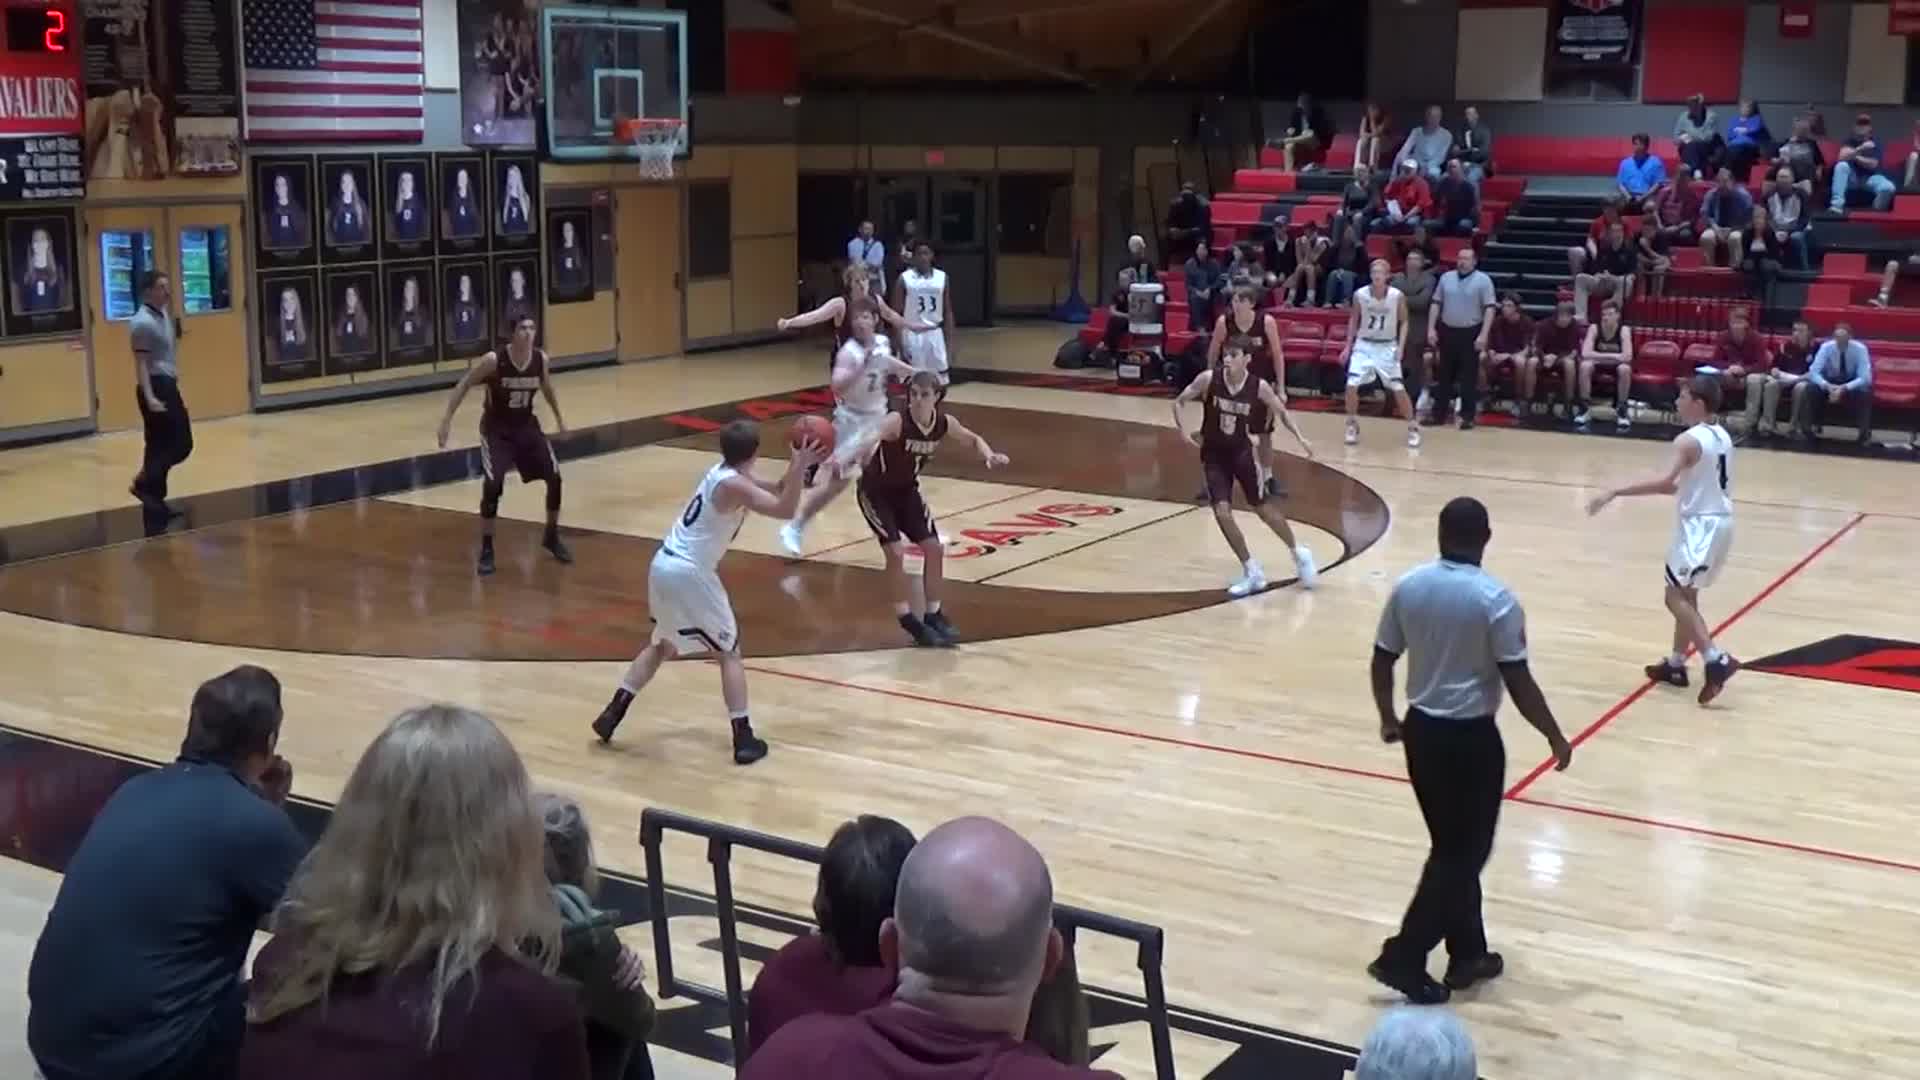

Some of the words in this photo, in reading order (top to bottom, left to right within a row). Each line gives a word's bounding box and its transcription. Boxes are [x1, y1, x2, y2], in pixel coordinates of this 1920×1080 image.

[46, 10, 64, 50] 2
[917, 295, 937, 313] 33
[1367, 314, 1386, 331] 21
[683, 493, 703, 528] 0
